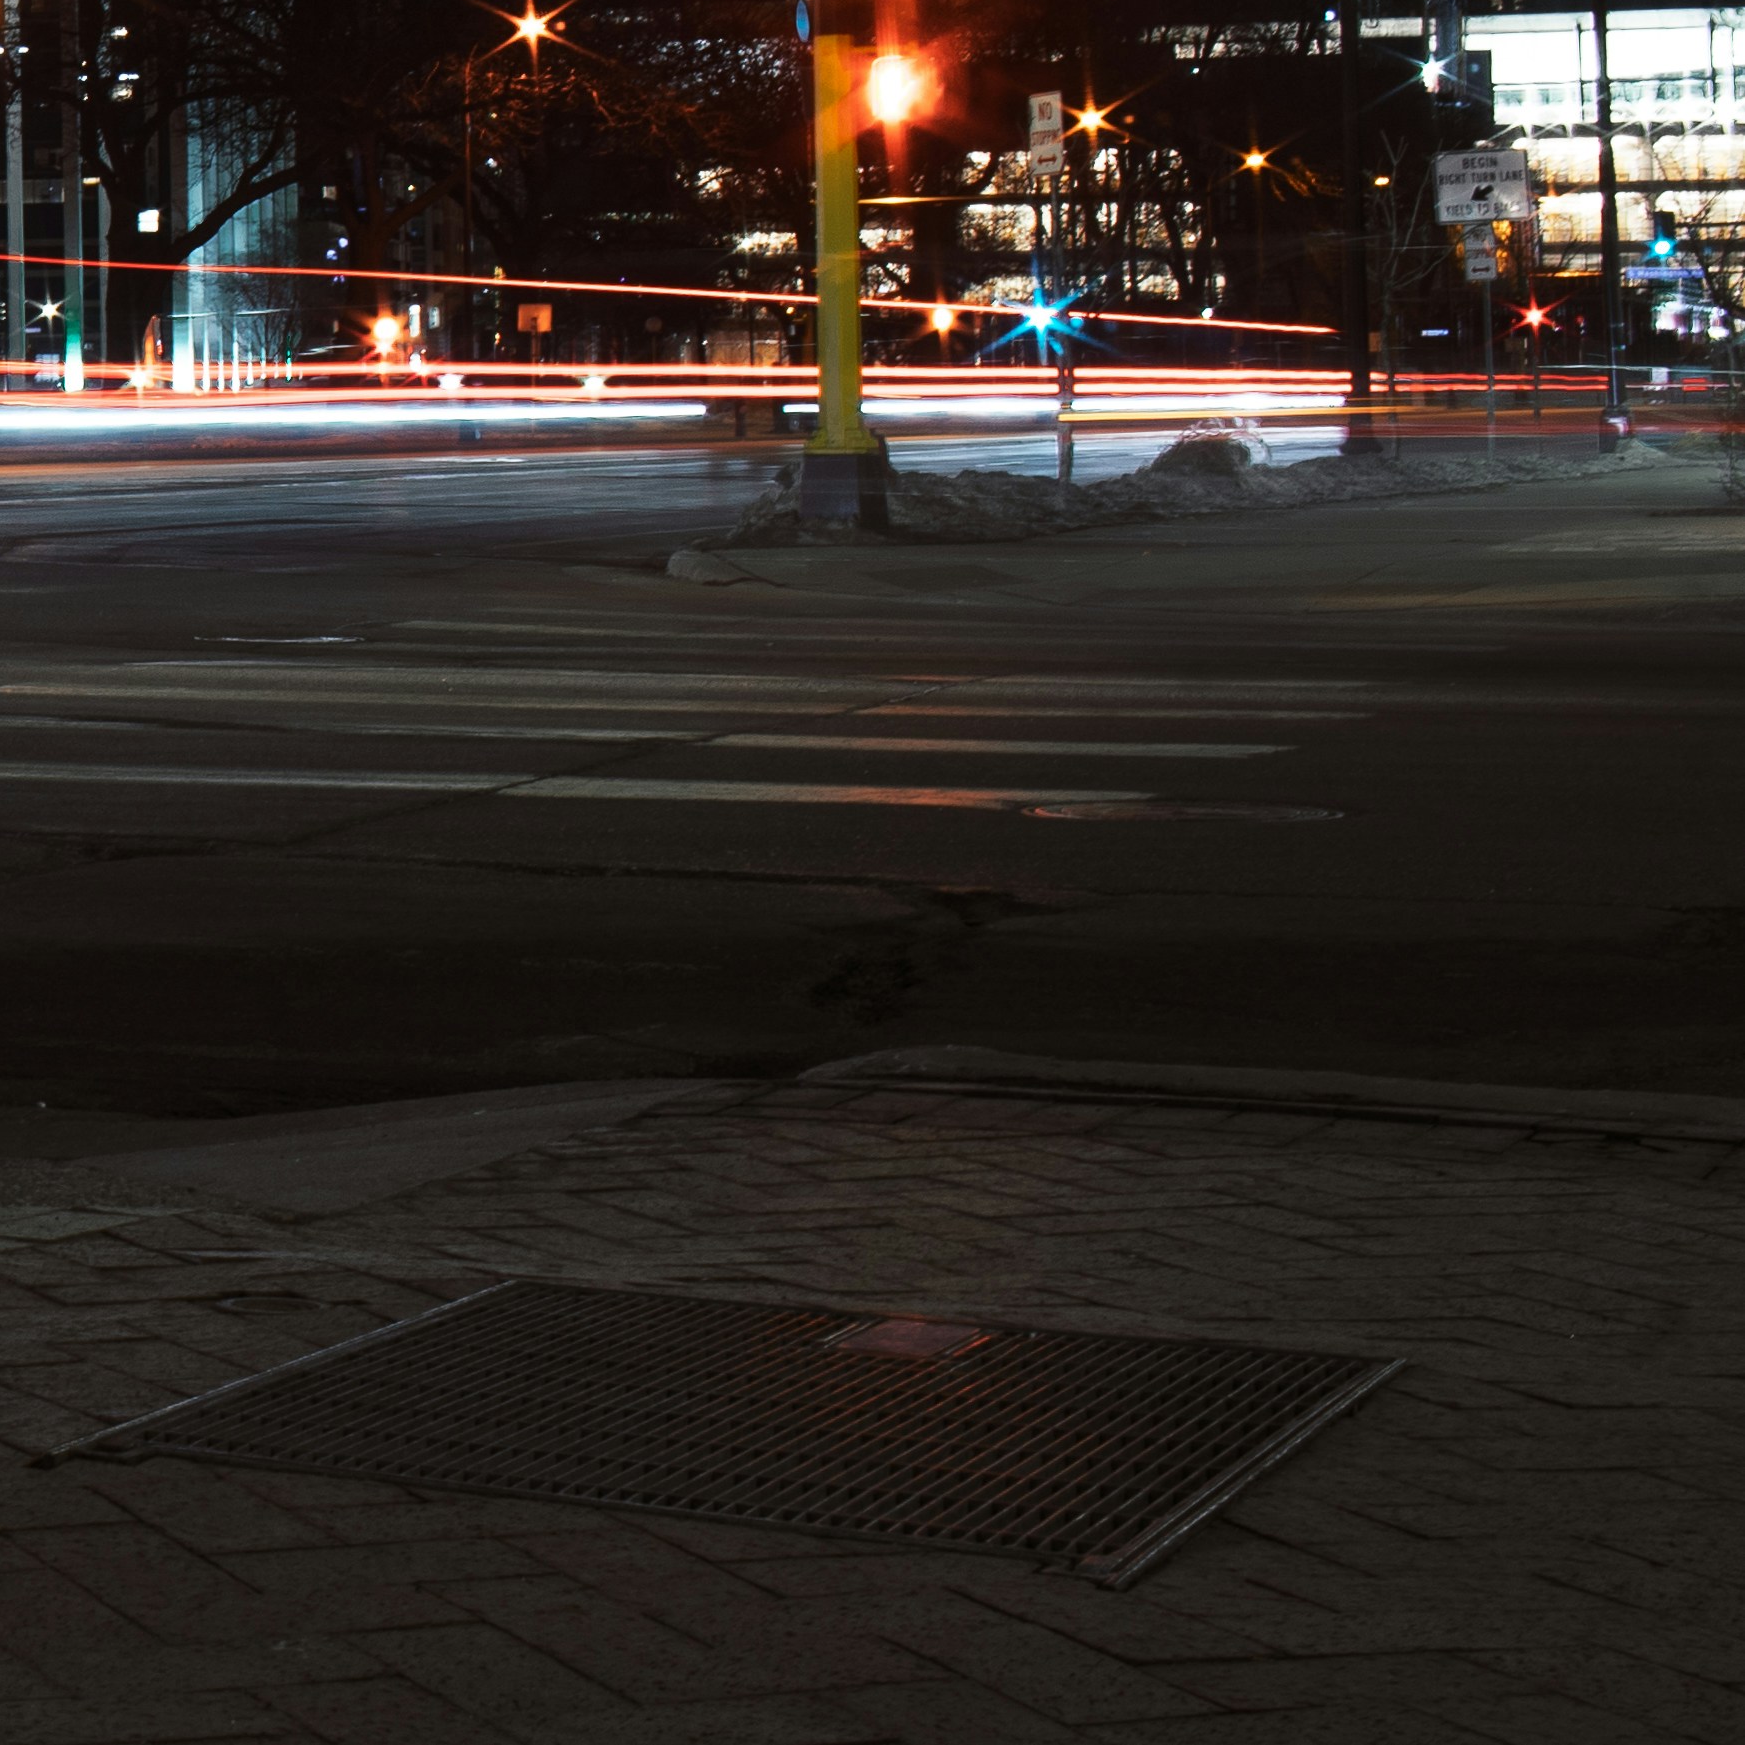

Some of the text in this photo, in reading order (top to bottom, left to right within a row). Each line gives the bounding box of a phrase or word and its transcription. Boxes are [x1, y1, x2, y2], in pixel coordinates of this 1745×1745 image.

[1462, 156, 1498, 169] BEGIN
[1438, 169, 1524, 185] RIGHT TURN LANE
